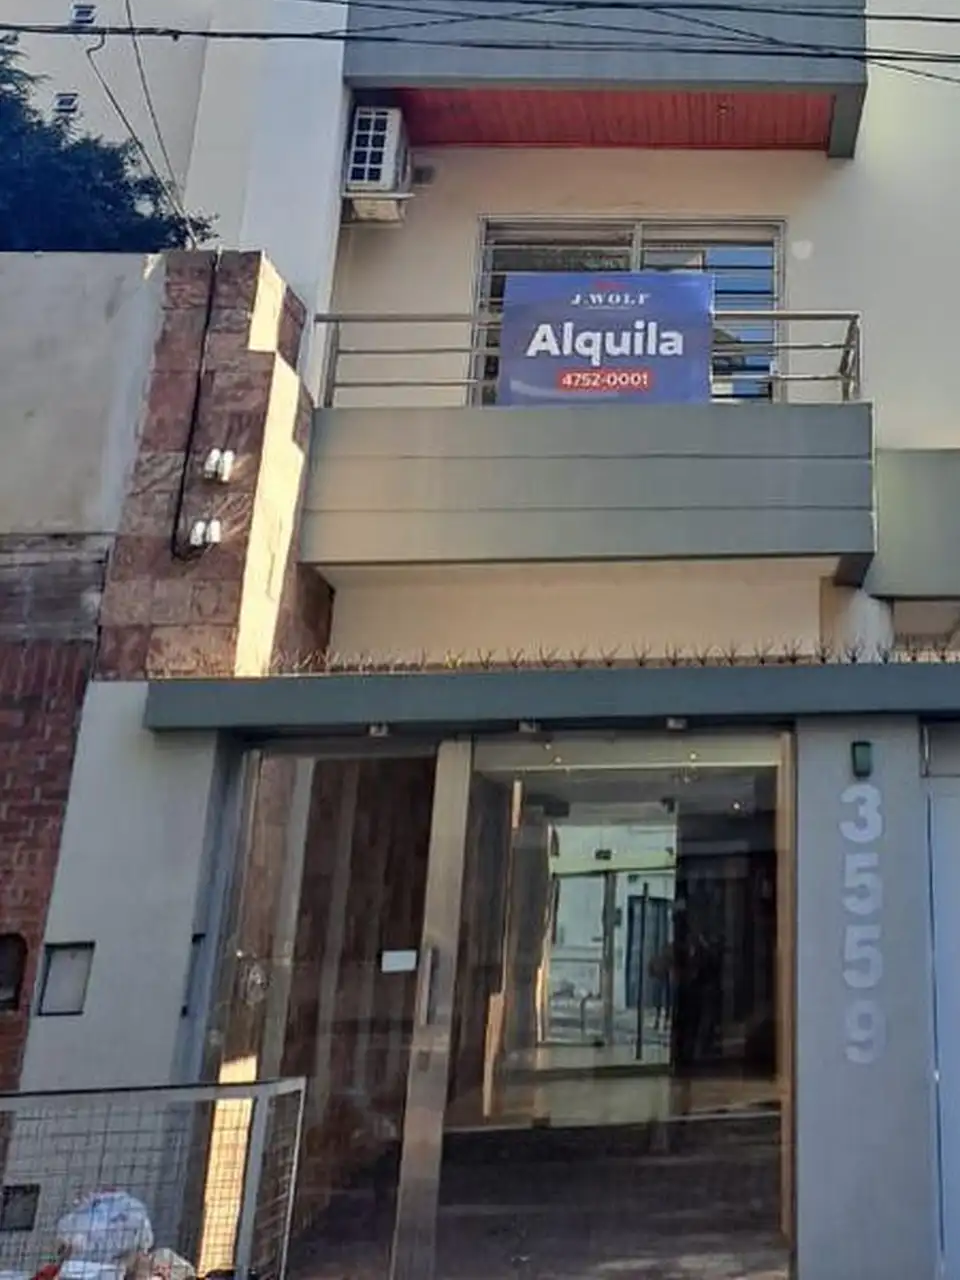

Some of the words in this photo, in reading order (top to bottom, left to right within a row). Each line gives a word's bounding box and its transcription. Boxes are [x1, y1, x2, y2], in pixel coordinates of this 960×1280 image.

[569, 292, 652, 305] J.WOLF
[526, 321, 684, 366] Alquila
[561, 372, 649, 388] 4752-0001
[839, 783, 886, 1065] 3559
